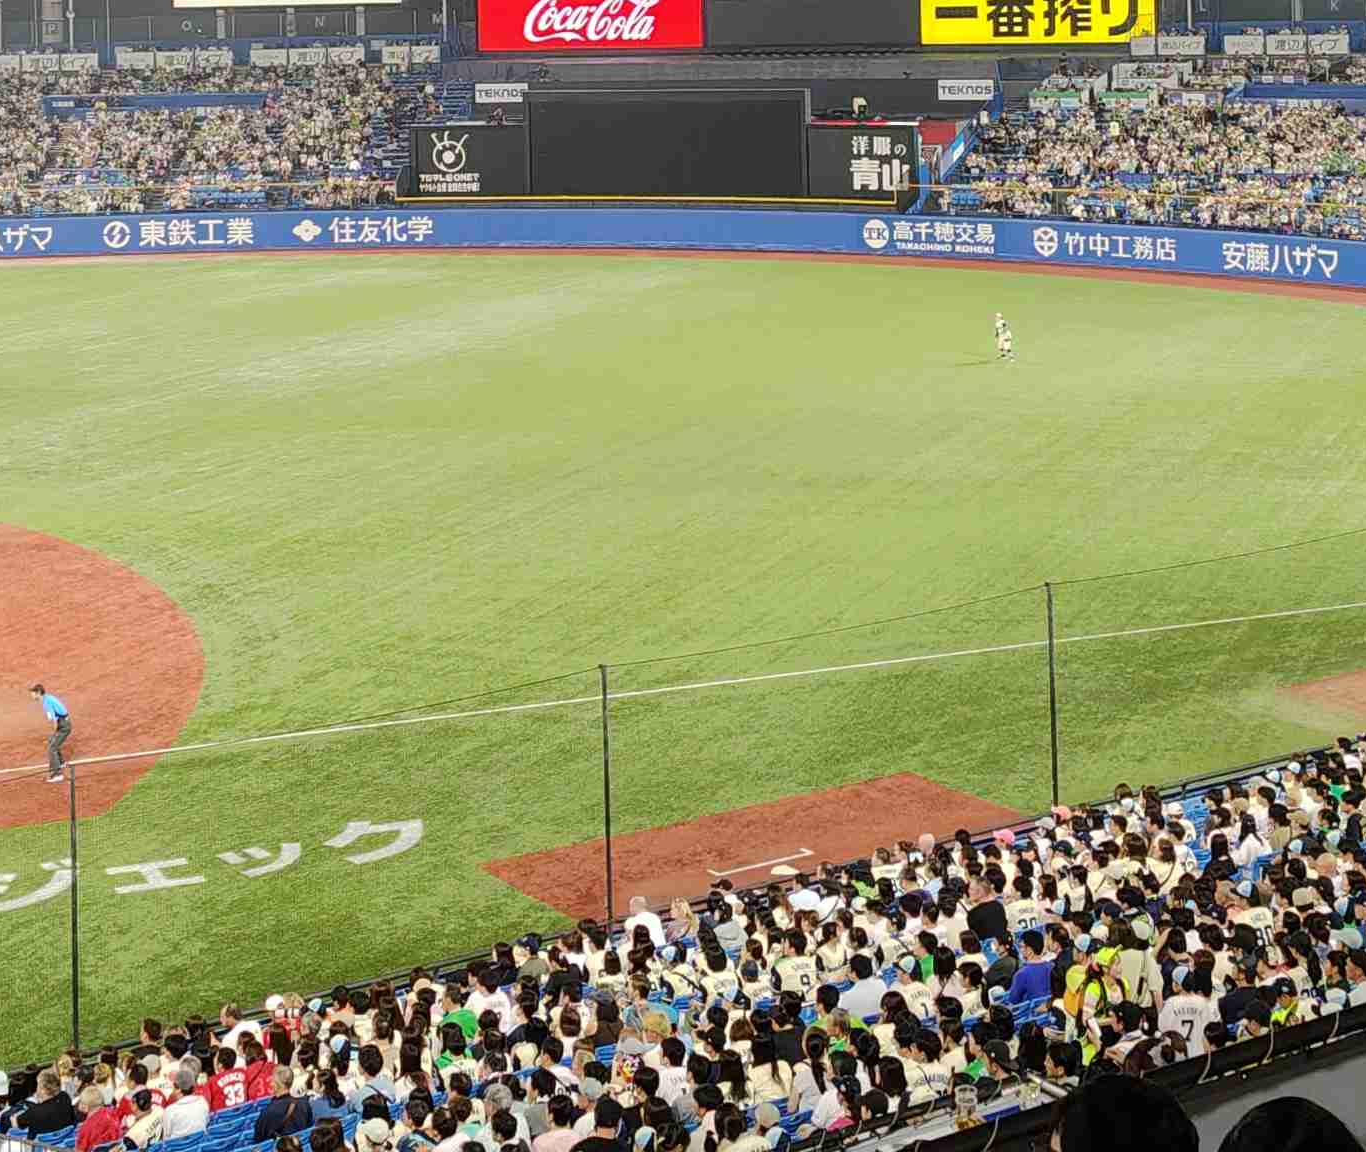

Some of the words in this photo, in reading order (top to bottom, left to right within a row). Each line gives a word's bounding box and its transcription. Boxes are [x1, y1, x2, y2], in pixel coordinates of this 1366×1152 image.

[851, 135, 907, 157] 洋服の
[850, 158, 910, 191] 青山
[139, 221, 254, 247] 東鉄工業
[329, 216, 433, 244] 住友化学
[893, 221, 995, 244] 高千穂交易
[1064, 232, 1177, 261] 竹中工務店
[1222, 241, 1338, 279] 安藤ハザマ
[1181, 1020, 1194, 1041] 7
[223, 1081, 245, 1106] 33
